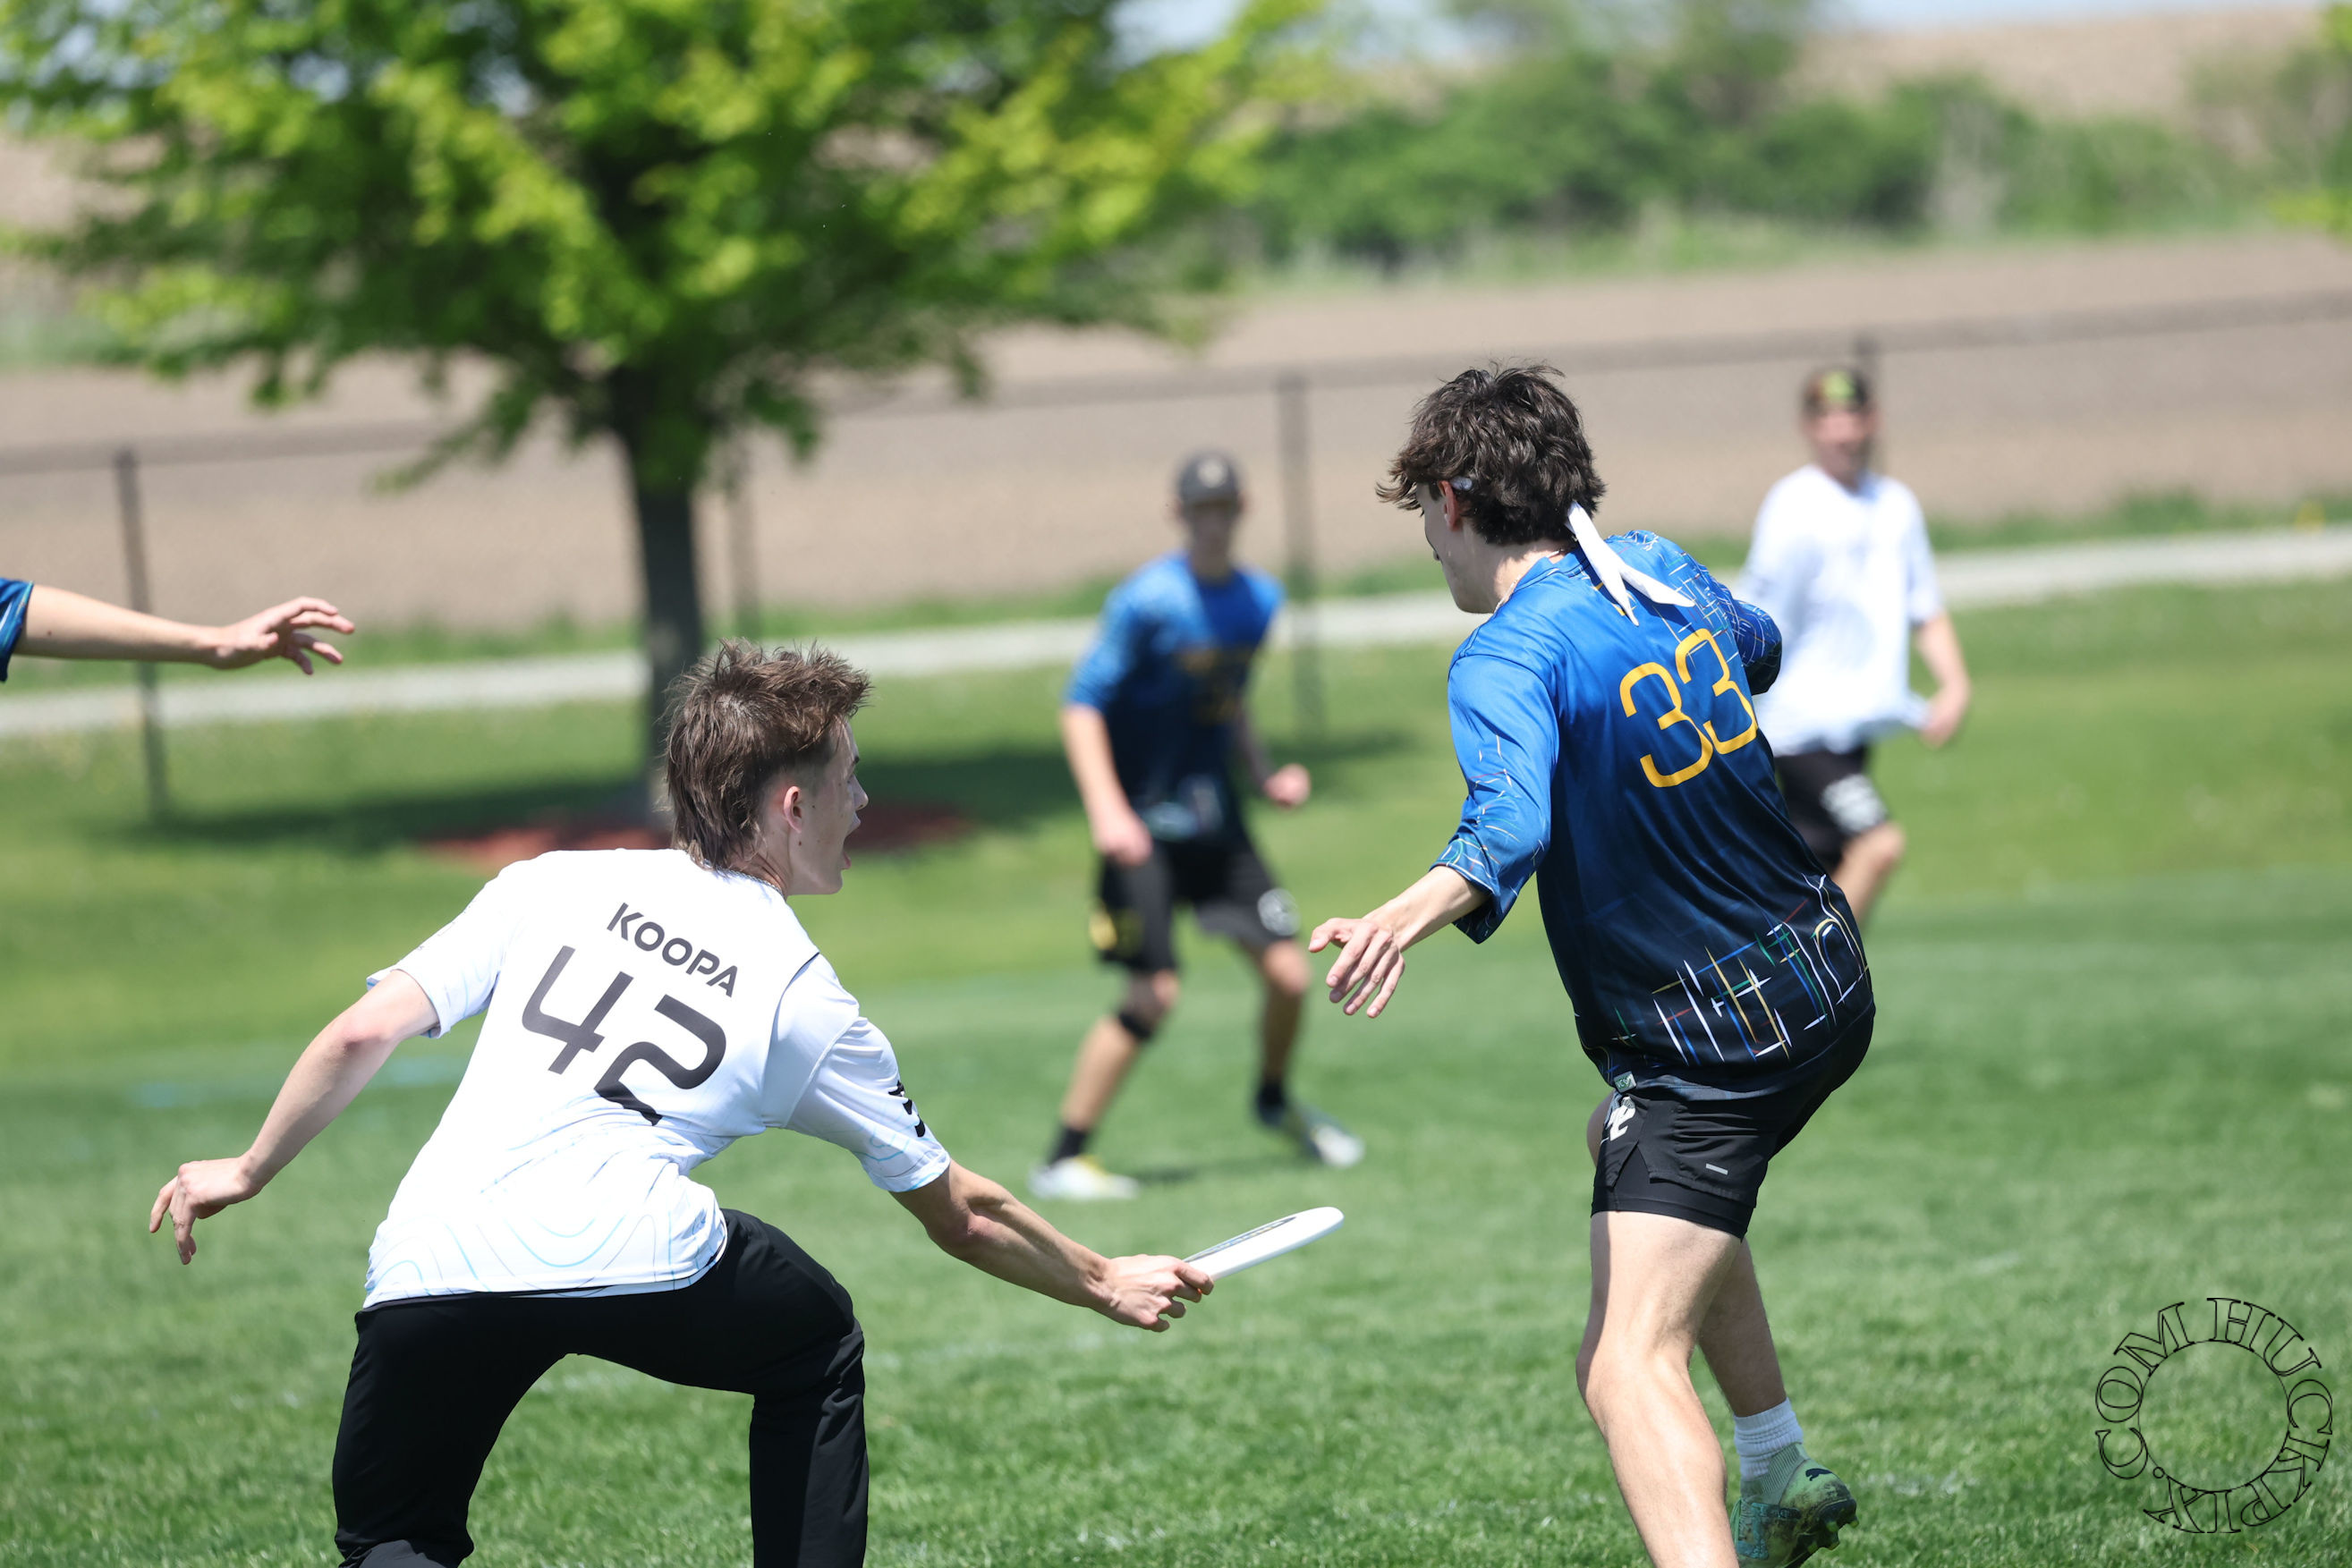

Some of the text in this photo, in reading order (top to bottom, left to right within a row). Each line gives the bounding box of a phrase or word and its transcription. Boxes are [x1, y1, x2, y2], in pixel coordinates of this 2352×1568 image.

[1619, 628, 1758, 787] 33
[607, 903, 738, 998] KOOPA
[522, 945, 727, 1126] 42
